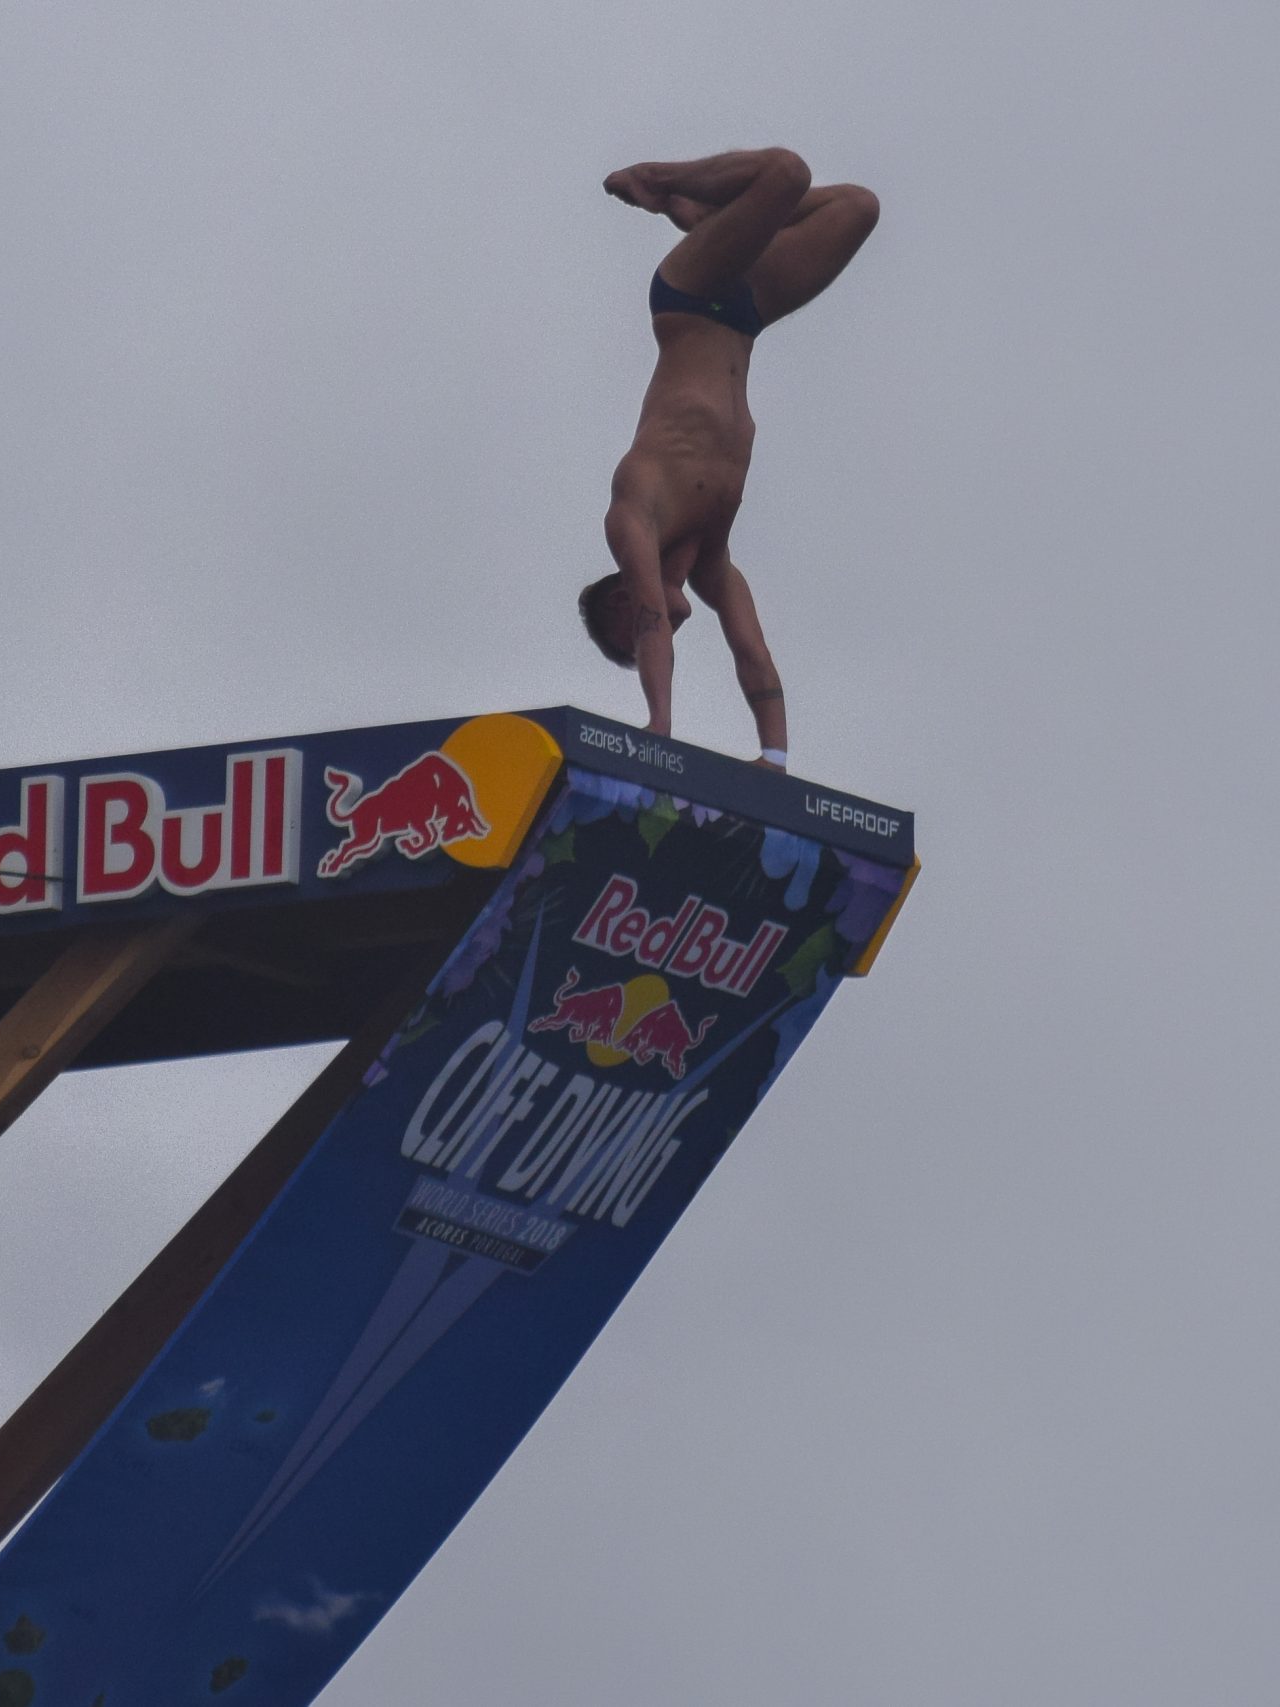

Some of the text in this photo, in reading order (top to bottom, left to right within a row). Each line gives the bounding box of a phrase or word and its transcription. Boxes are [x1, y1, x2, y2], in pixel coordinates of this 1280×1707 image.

[580, 724, 684, 775] azores airlines
[78, 750, 300, 903] Bull
[806, 794, 900, 838] LIFEPROOF
[573, 874, 788, 998] Red Bull
[401, 1020, 709, 1228] CLIFF DIVING
[412, 1182, 567, 1250] WORLD SERIES 2018
[469, 1234, 525, 1265] PORTUGAL
